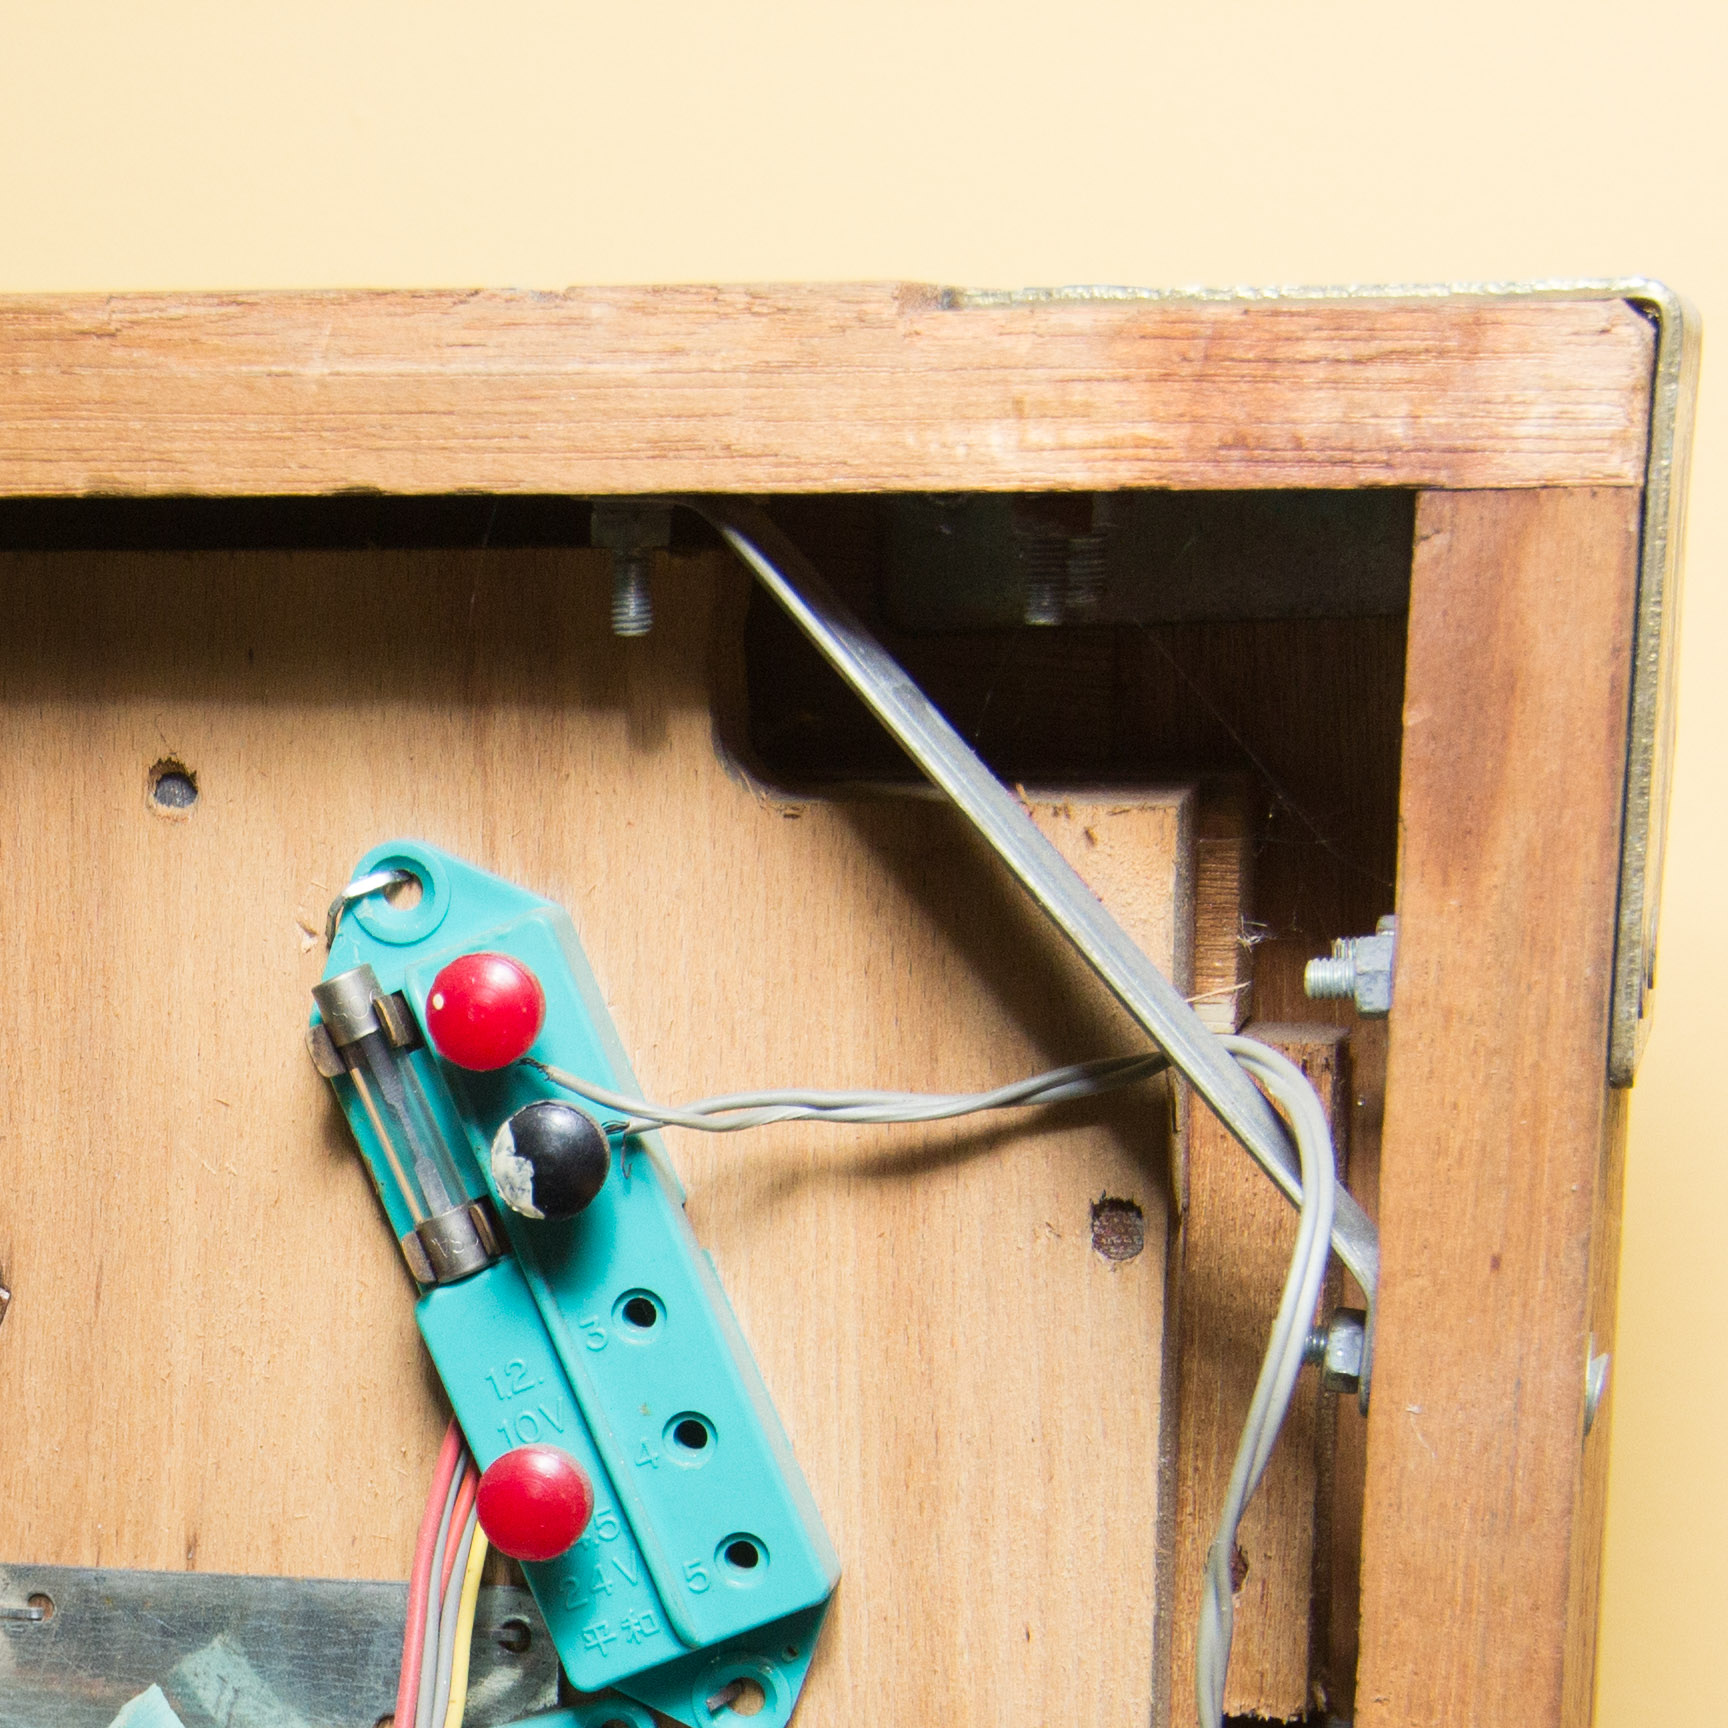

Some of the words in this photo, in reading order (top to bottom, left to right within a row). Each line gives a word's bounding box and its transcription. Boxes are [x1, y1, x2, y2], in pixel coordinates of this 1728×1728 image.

[579, 1314, 609, 1353] 3
[496, 1396, 565, 1449] 10V
[634, 1436, 660, 1470] 4
[560, 1549, 639, 1612] 24V
[682, 1557, 712, 1595] 5
[581, 1608, 661, 1659] 平和
